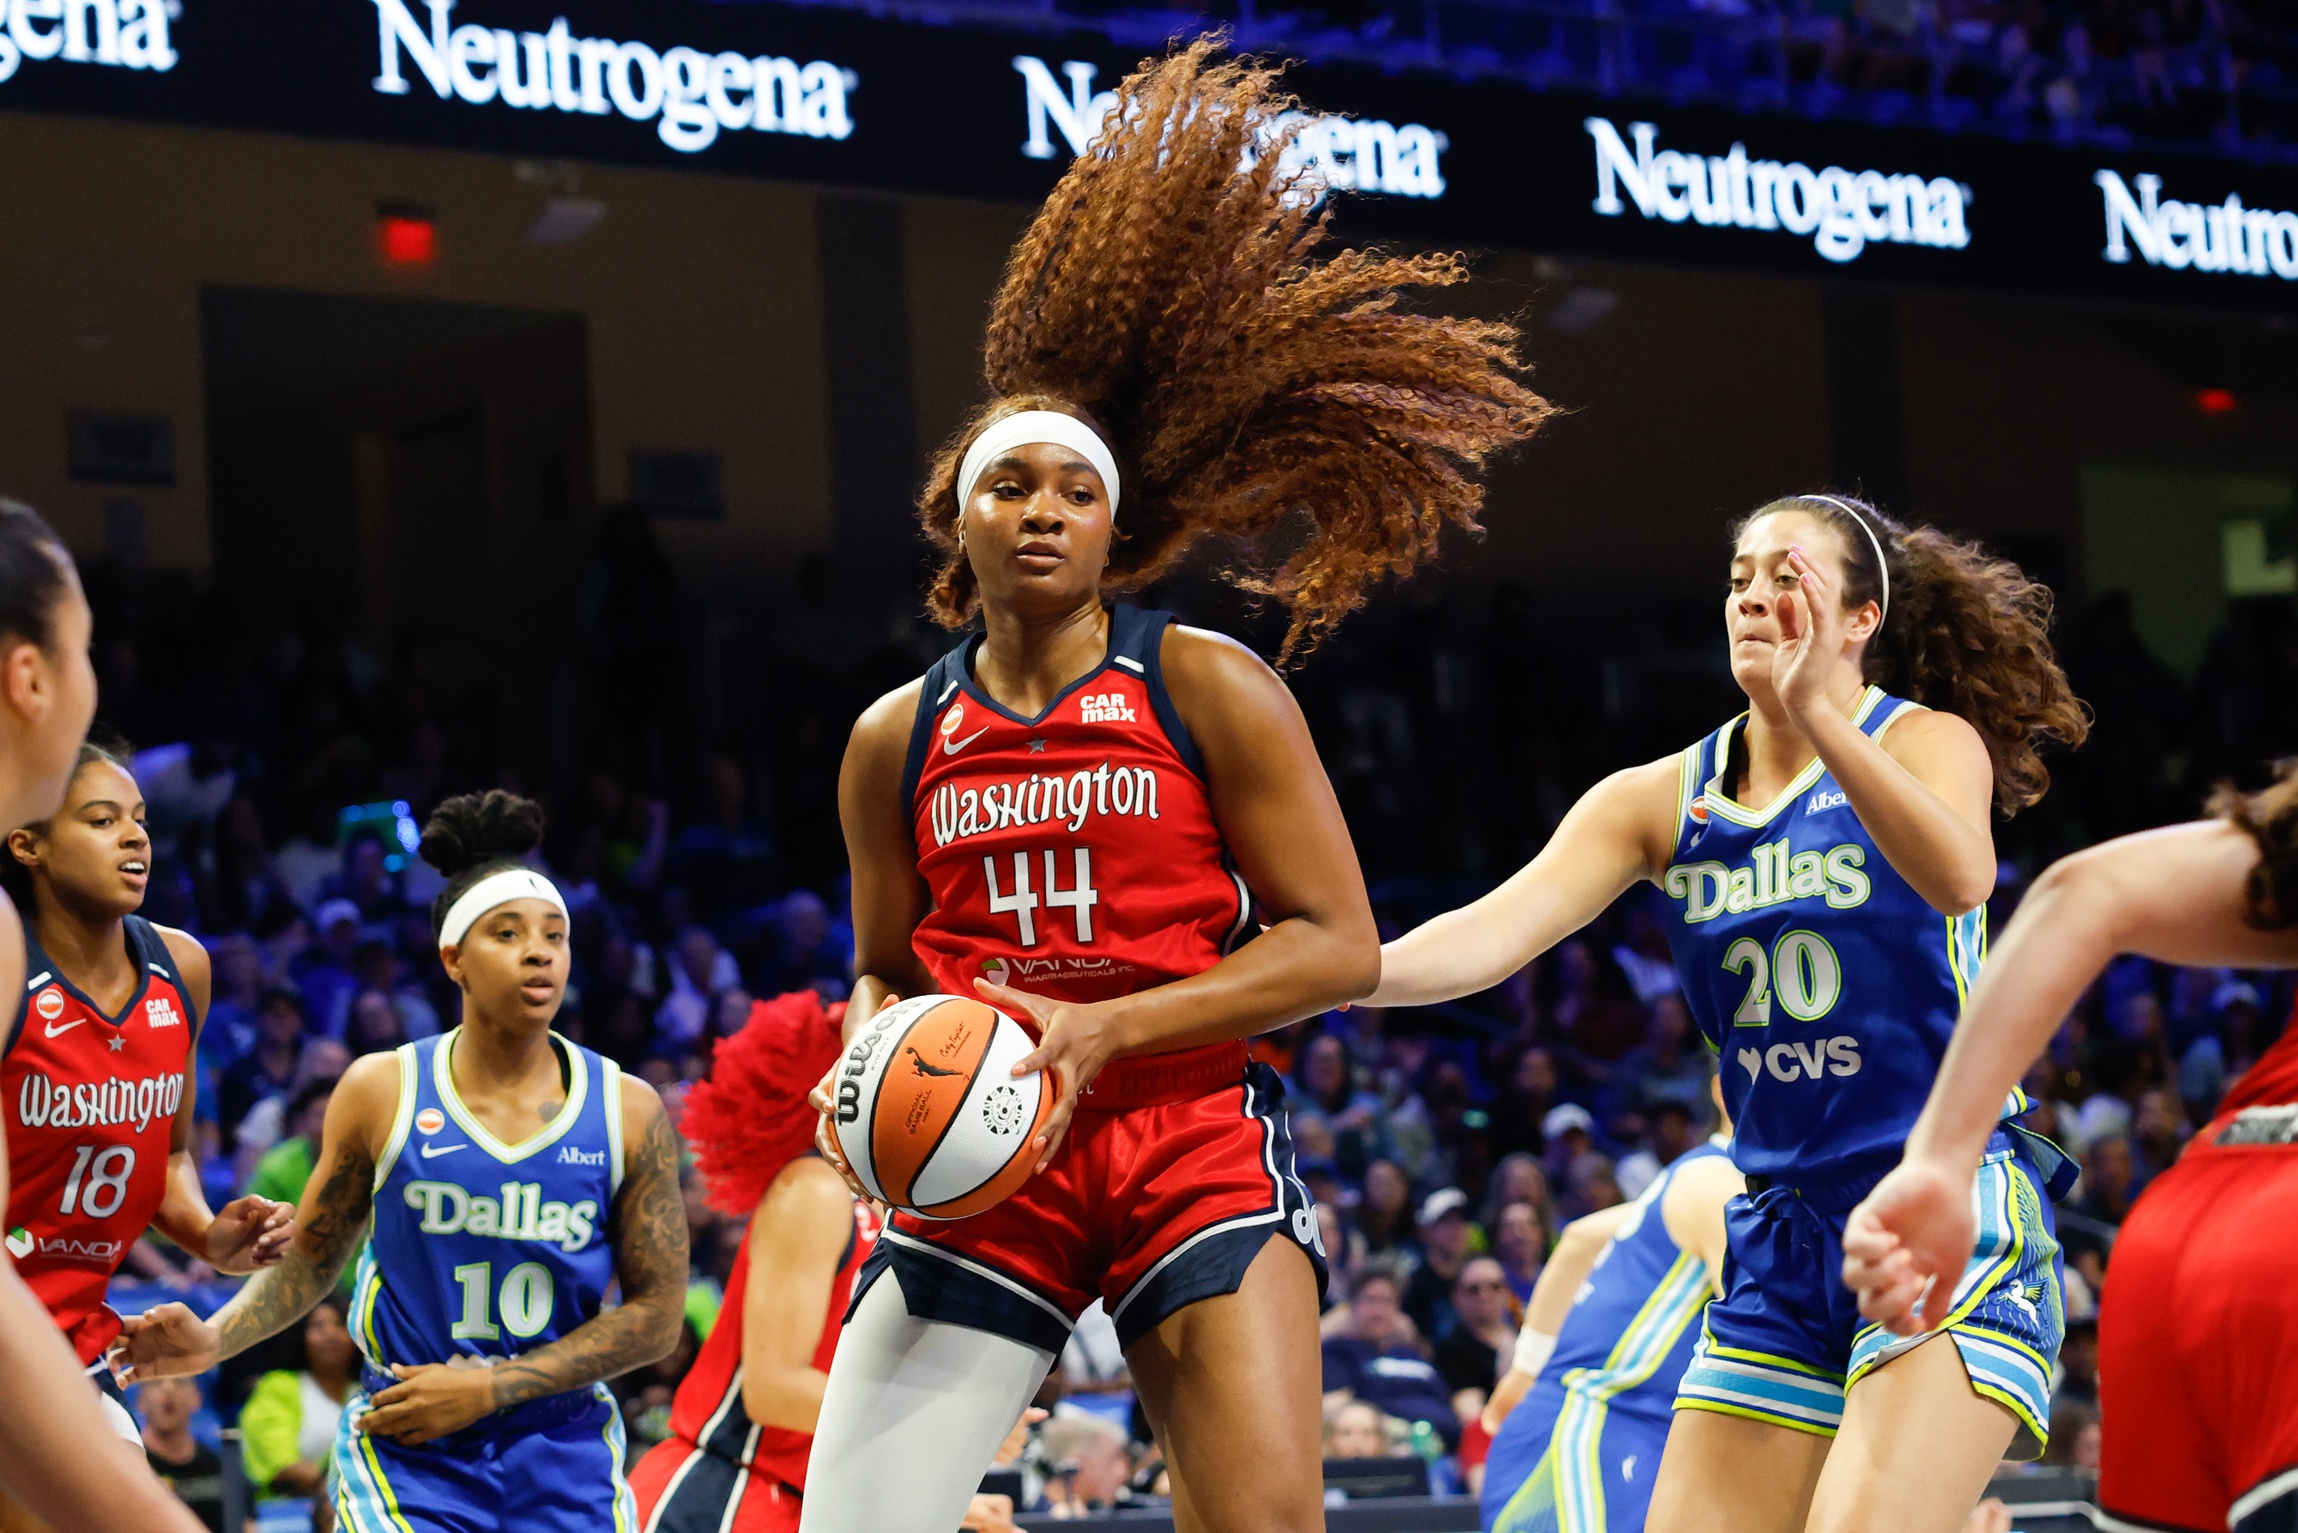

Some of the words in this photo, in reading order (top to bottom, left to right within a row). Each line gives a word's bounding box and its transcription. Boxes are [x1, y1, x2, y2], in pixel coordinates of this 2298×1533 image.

[373, 0, 856, 152] Neutrogena
[1586, 117, 1970, 263] Neutrogena
[1080, 693, 1126, 710] CAR
[1081, 706, 1136, 724] max
[930, 757, 1160, 848] Washington
[1804, 791, 1848, 815] Alber
[983, 846, 1098, 947] 44
[1664, 837, 1871, 924] Dallas
[145, 998, 171, 1014] CAR
[1721, 929, 1842, 1028] 20
[148, 1010, 180, 1028] max
[837, 1000, 923, 1128] Wilson
[1765, 1035, 1862, 1082] CVS
[59, 1144, 136, 1218] 18
[557, 1145, 606, 1167] Albert
[403, 1179, 598, 1252] Dallas
[451, 1261, 554, 1340] 10
